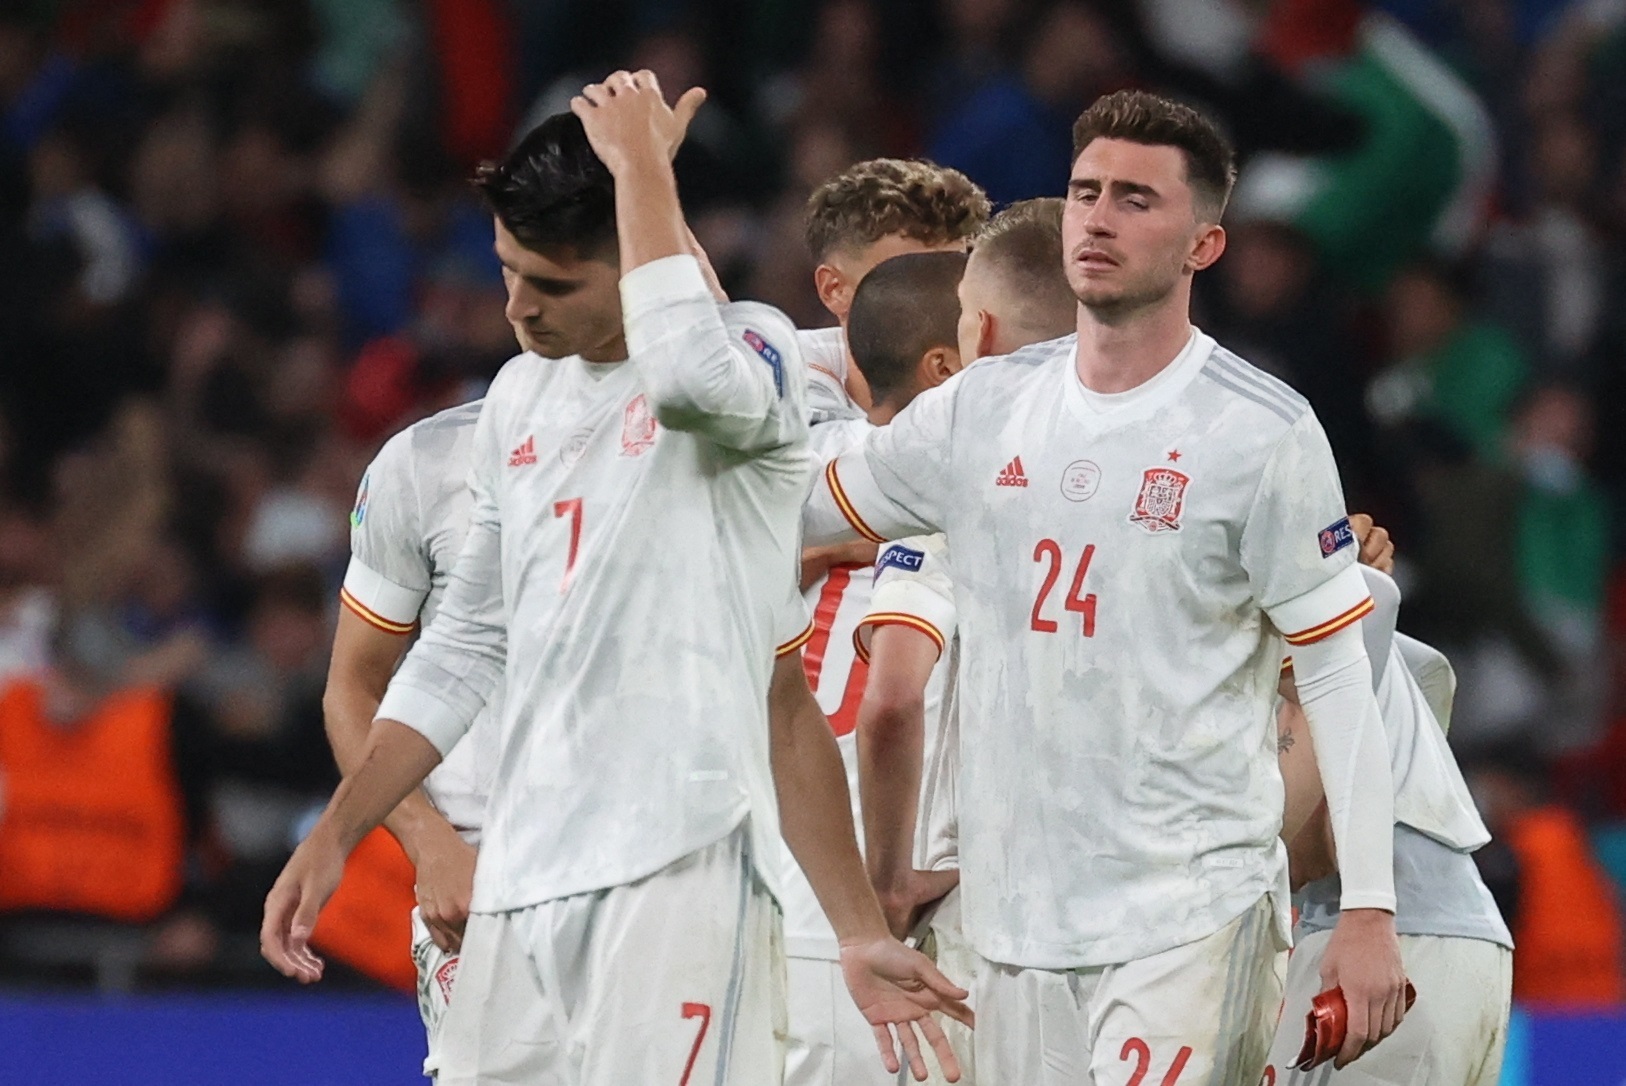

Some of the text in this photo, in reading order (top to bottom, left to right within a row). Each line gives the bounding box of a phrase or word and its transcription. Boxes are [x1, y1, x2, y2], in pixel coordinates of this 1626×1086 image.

[996, 476, 1028, 488] adidas
[553, 497, 582, 594] 7
[1031, 538, 1097, 637] 24
[679, 1002, 711, 1086] 7
